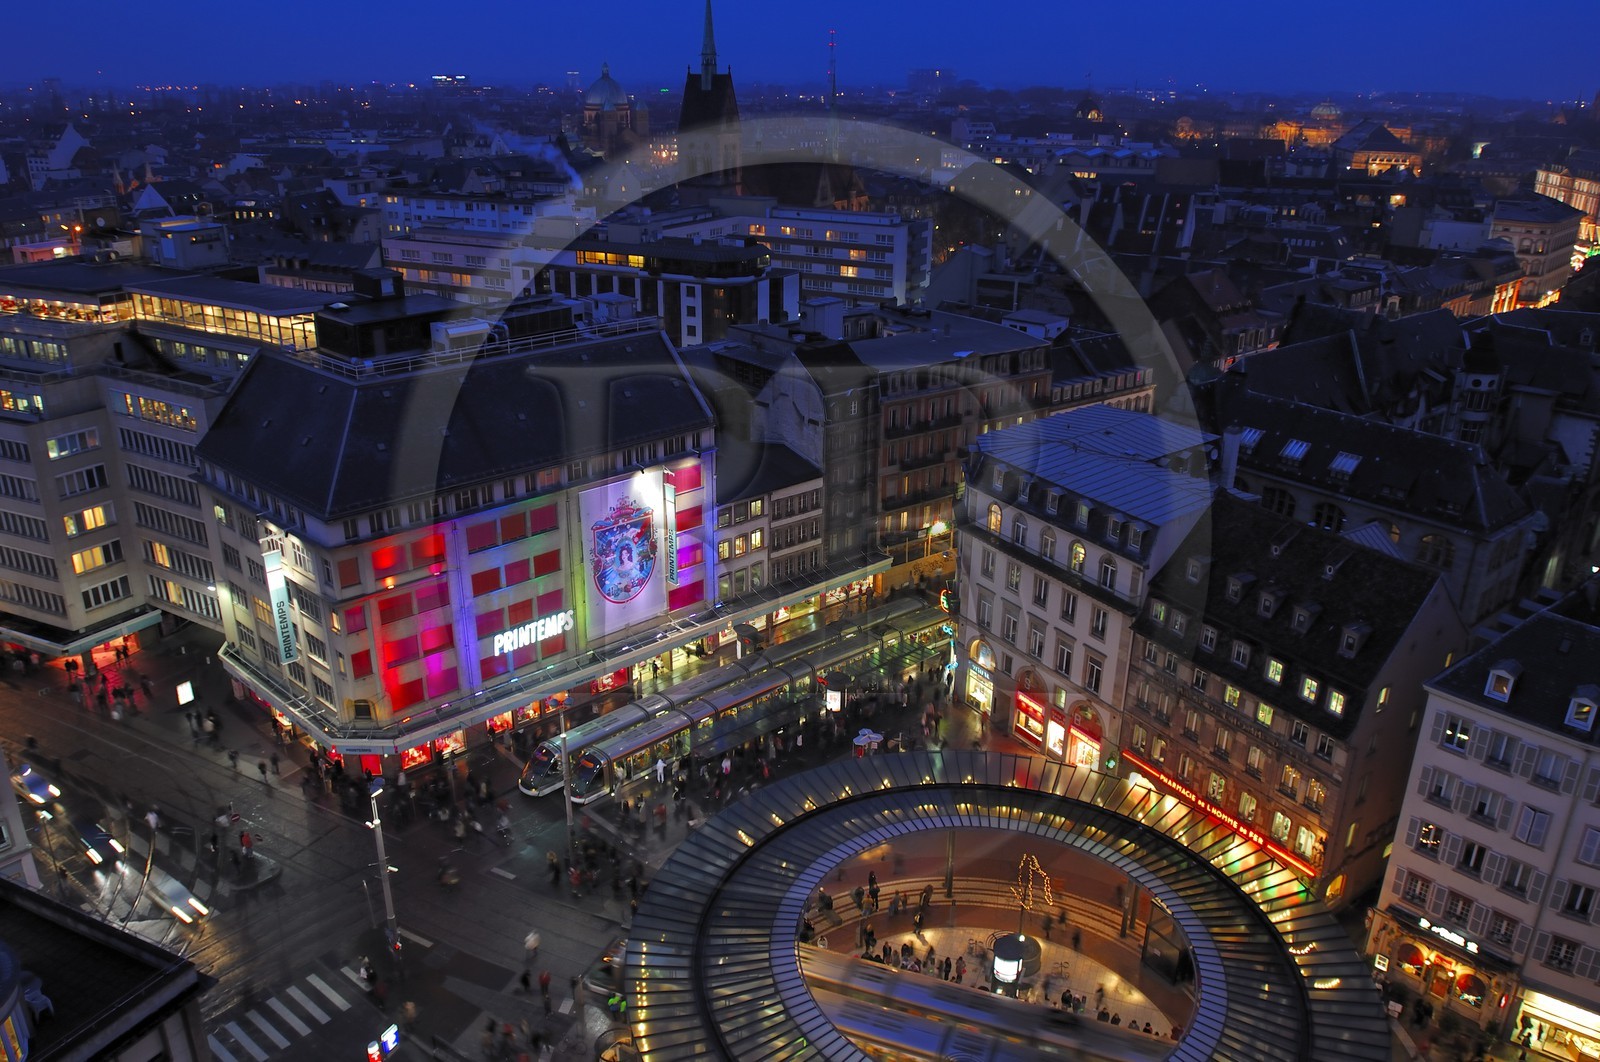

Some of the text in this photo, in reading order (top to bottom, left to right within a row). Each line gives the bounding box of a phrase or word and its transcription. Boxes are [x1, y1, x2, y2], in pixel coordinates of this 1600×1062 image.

[276, 600, 294, 659] PRINTEMPS
[494, 610, 574, 656] PRINTEMPS
[1159, 774, 1196, 802] PHARMACIE
[1206, 804, 1239, 829] LHOMME
[1248, 830, 1264, 845] FER
